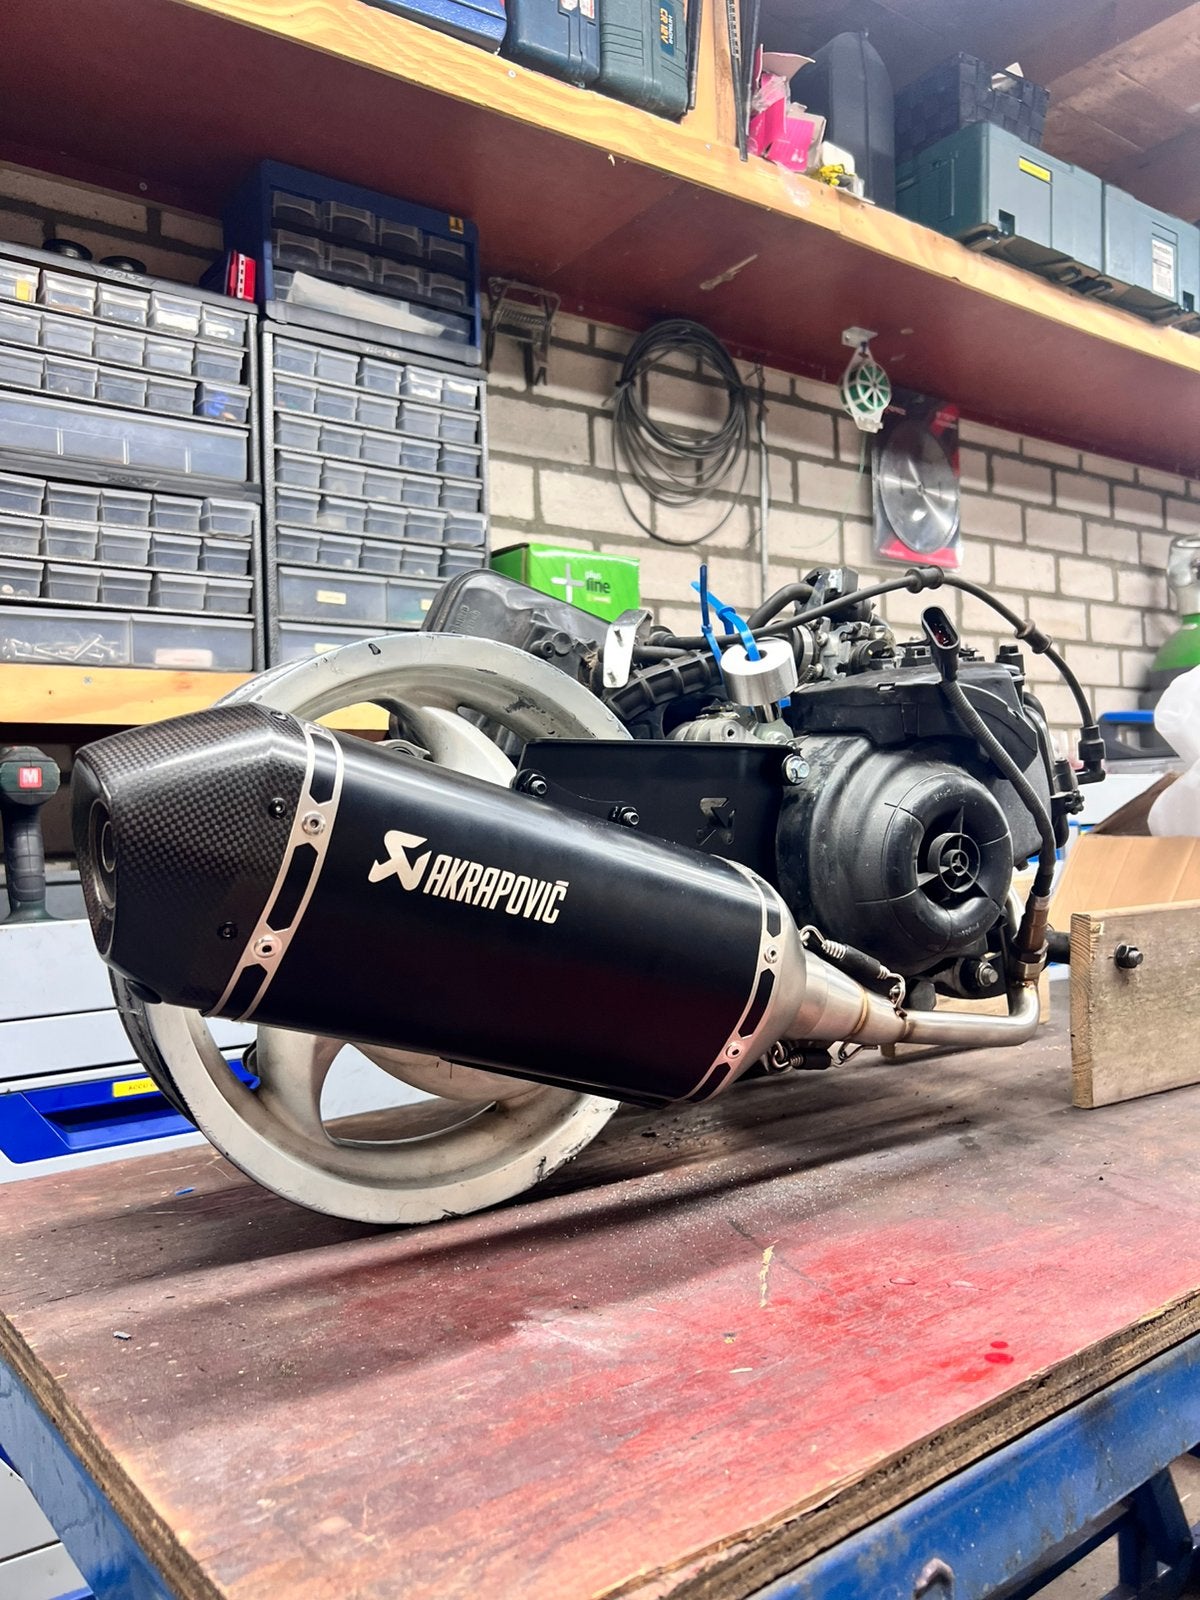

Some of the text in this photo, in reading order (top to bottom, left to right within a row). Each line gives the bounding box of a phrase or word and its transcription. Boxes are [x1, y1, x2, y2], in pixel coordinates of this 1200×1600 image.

[660, 7, 669, 24] CR
[586, 577, 610, 594] line
[22, 768, 39, 785] M
[422, 853, 570, 924] AKRAPOVIČ
